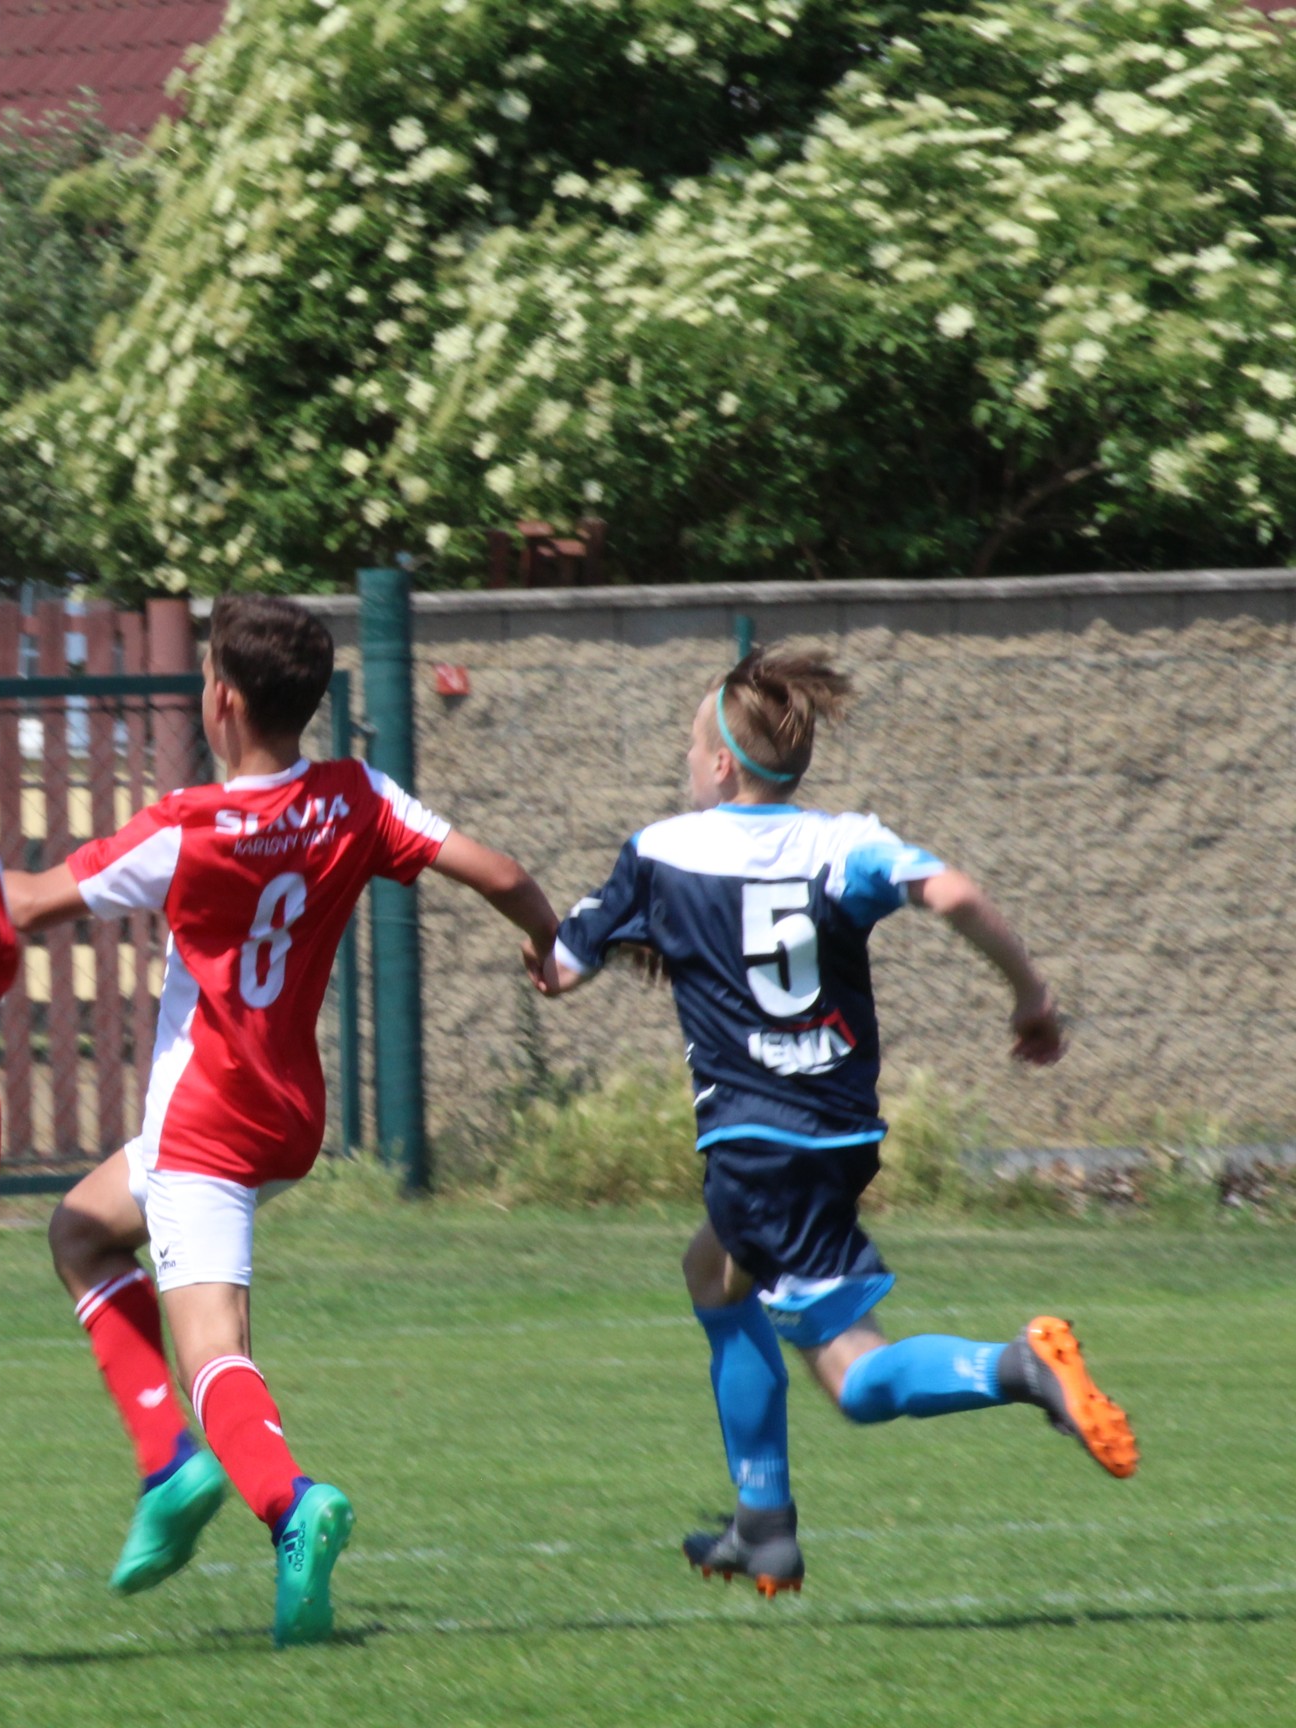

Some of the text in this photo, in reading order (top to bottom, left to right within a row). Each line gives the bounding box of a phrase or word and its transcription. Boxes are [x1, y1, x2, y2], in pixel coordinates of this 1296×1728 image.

[214, 793, 351, 836] SLAVIA
[239, 871, 308, 1010] 8
[741, 880, 822, 1018] 5
[292, 1519, 307, 1573] adidas
